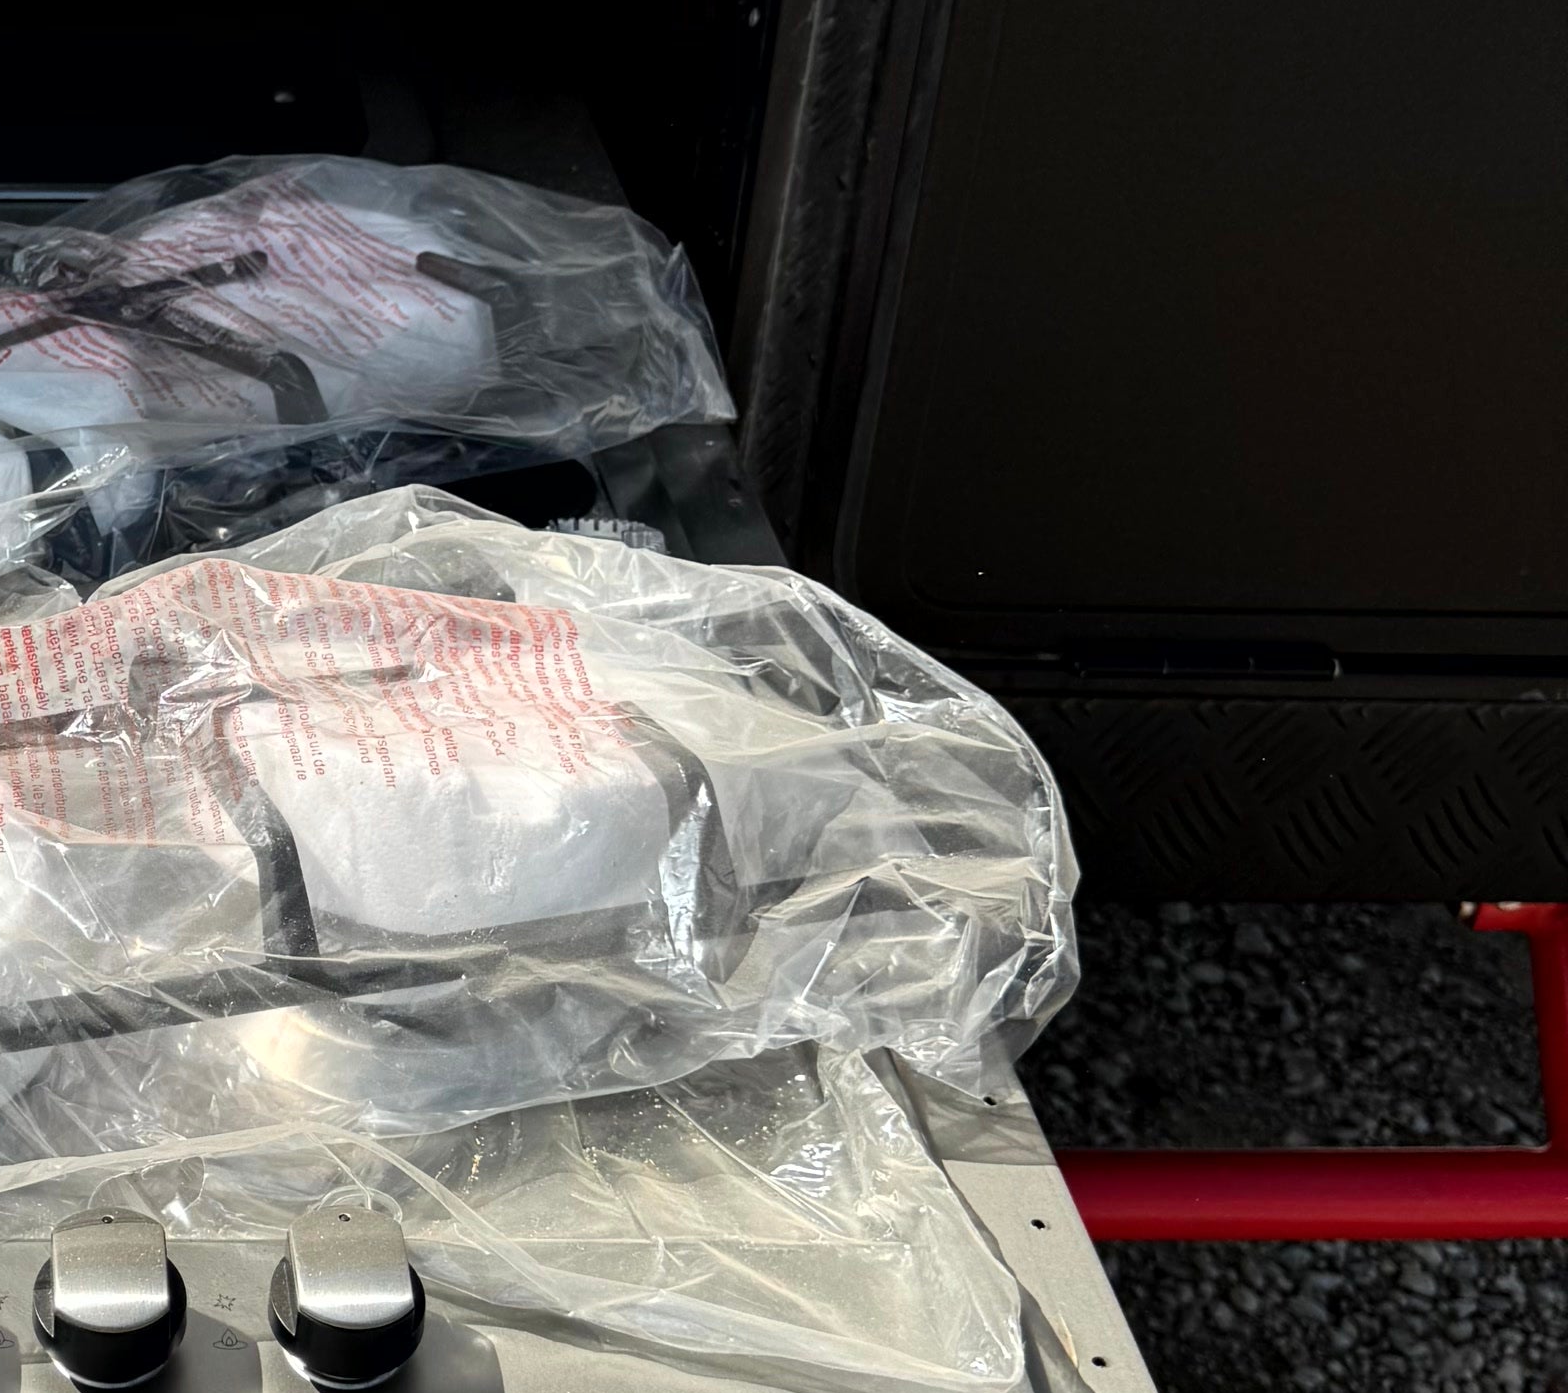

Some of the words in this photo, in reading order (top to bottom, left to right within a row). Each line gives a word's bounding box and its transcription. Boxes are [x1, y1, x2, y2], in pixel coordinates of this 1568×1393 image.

[90, 642, 102, 656] от
[100, 605, 126, 674] опасности
[47, 628, 70, 693] детскими
[566, 653, 594, 696] possono
[93, 661, 113, 701] детей
[357, 739, 371, 763] und
[442, 728, 459, 762] evitar
[313, 760, 325, 775] de
